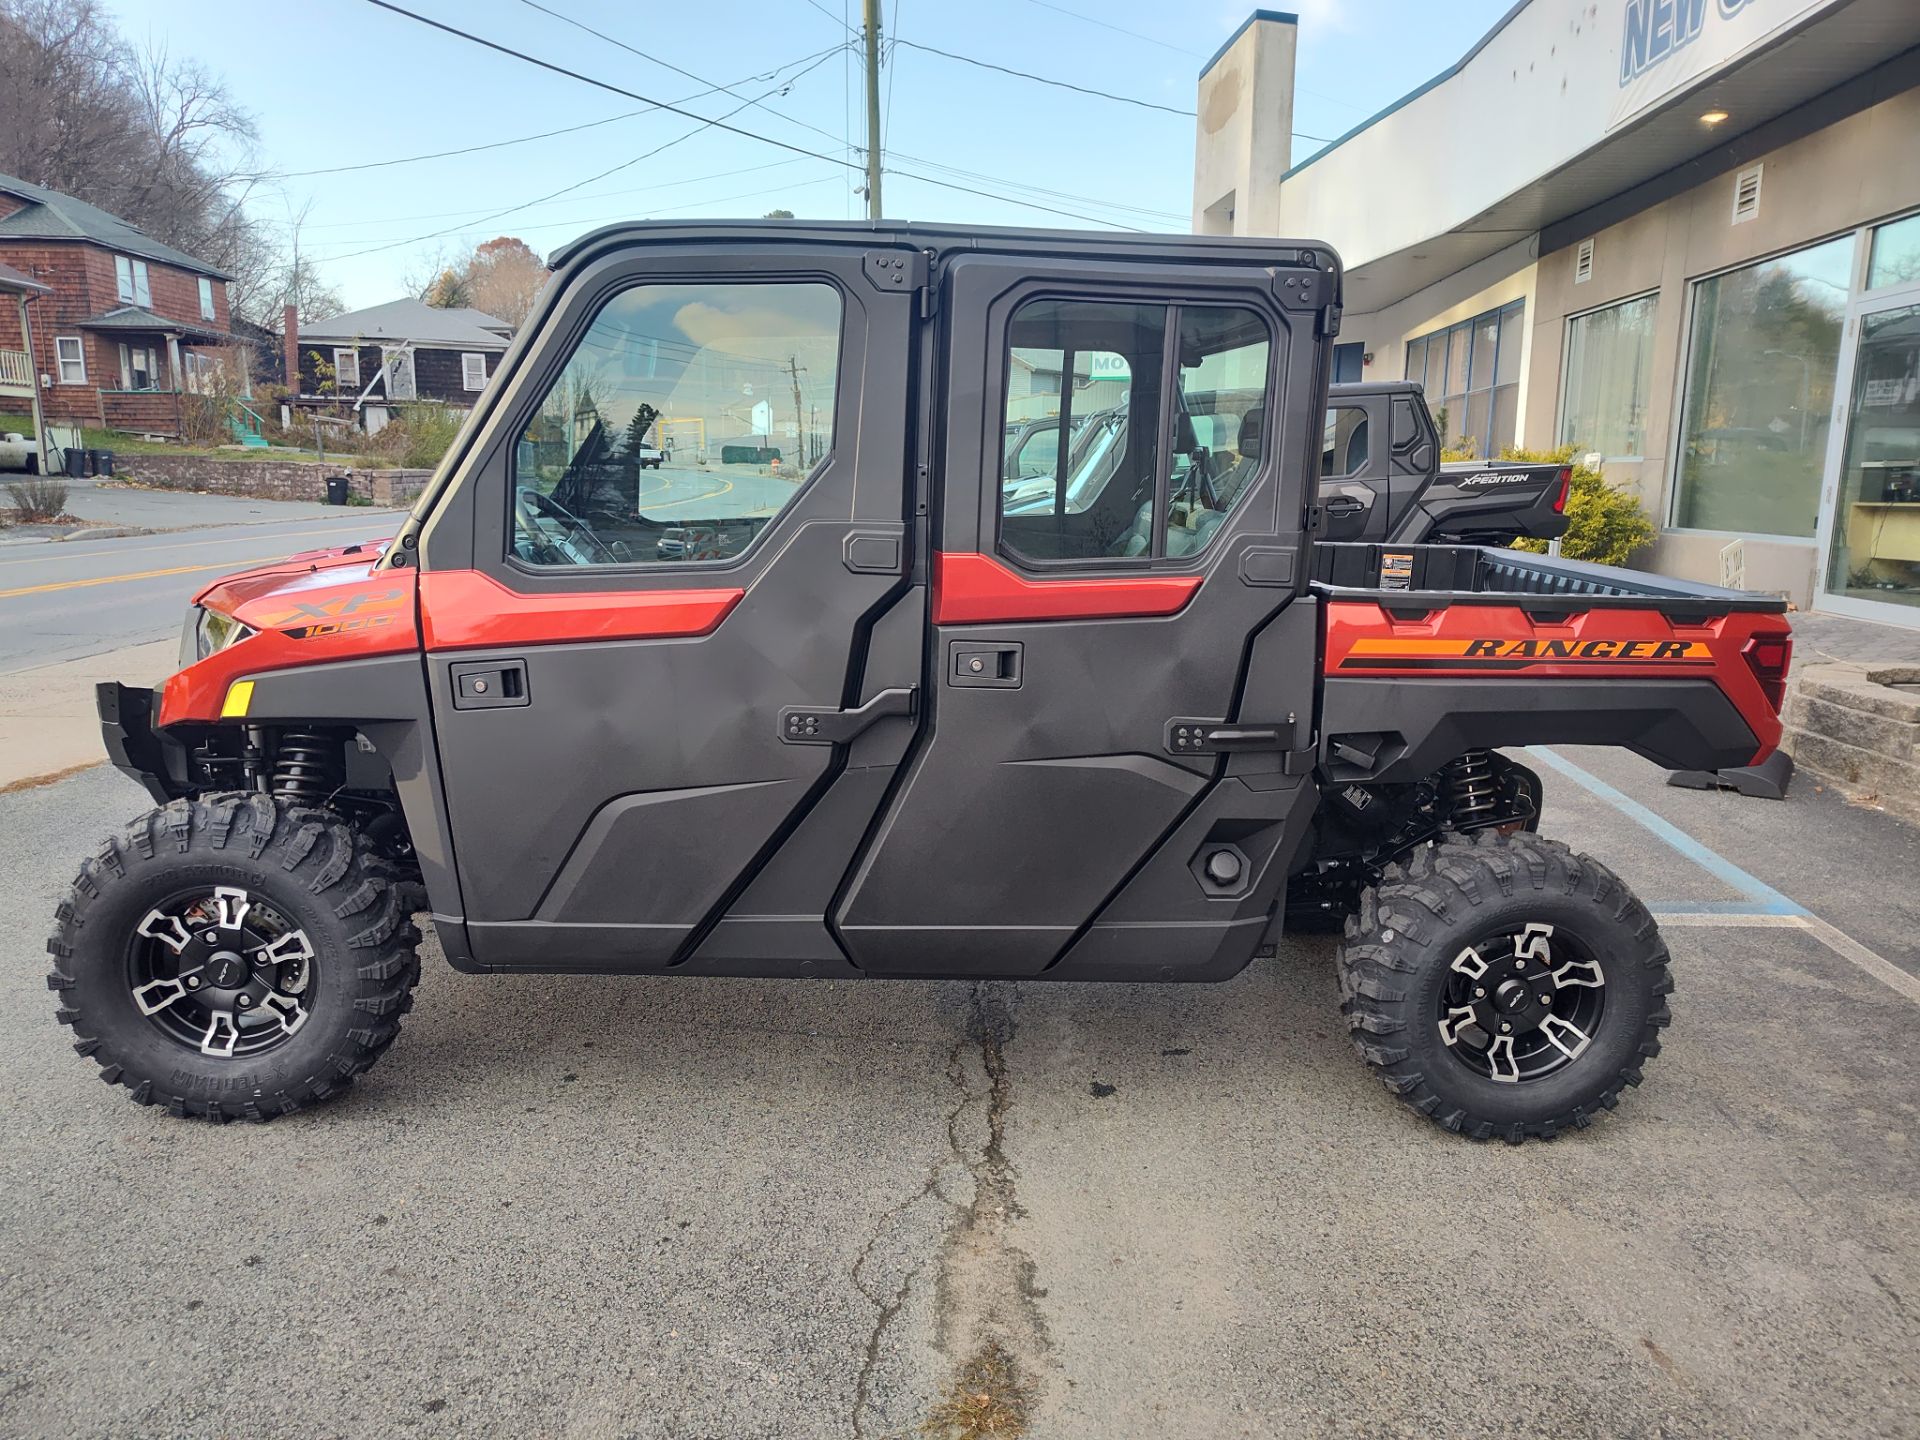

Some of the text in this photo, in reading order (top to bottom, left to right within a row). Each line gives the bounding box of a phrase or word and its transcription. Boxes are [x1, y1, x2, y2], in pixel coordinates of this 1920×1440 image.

[1620, 0, 1708, 87] NEW
[1457, 473, 1529, 488] XPEDITION
[275, 588, 404, 625] XP
[305, 615, 396, 638] 1000
[1462, 639, 1693, 659] RANGER
